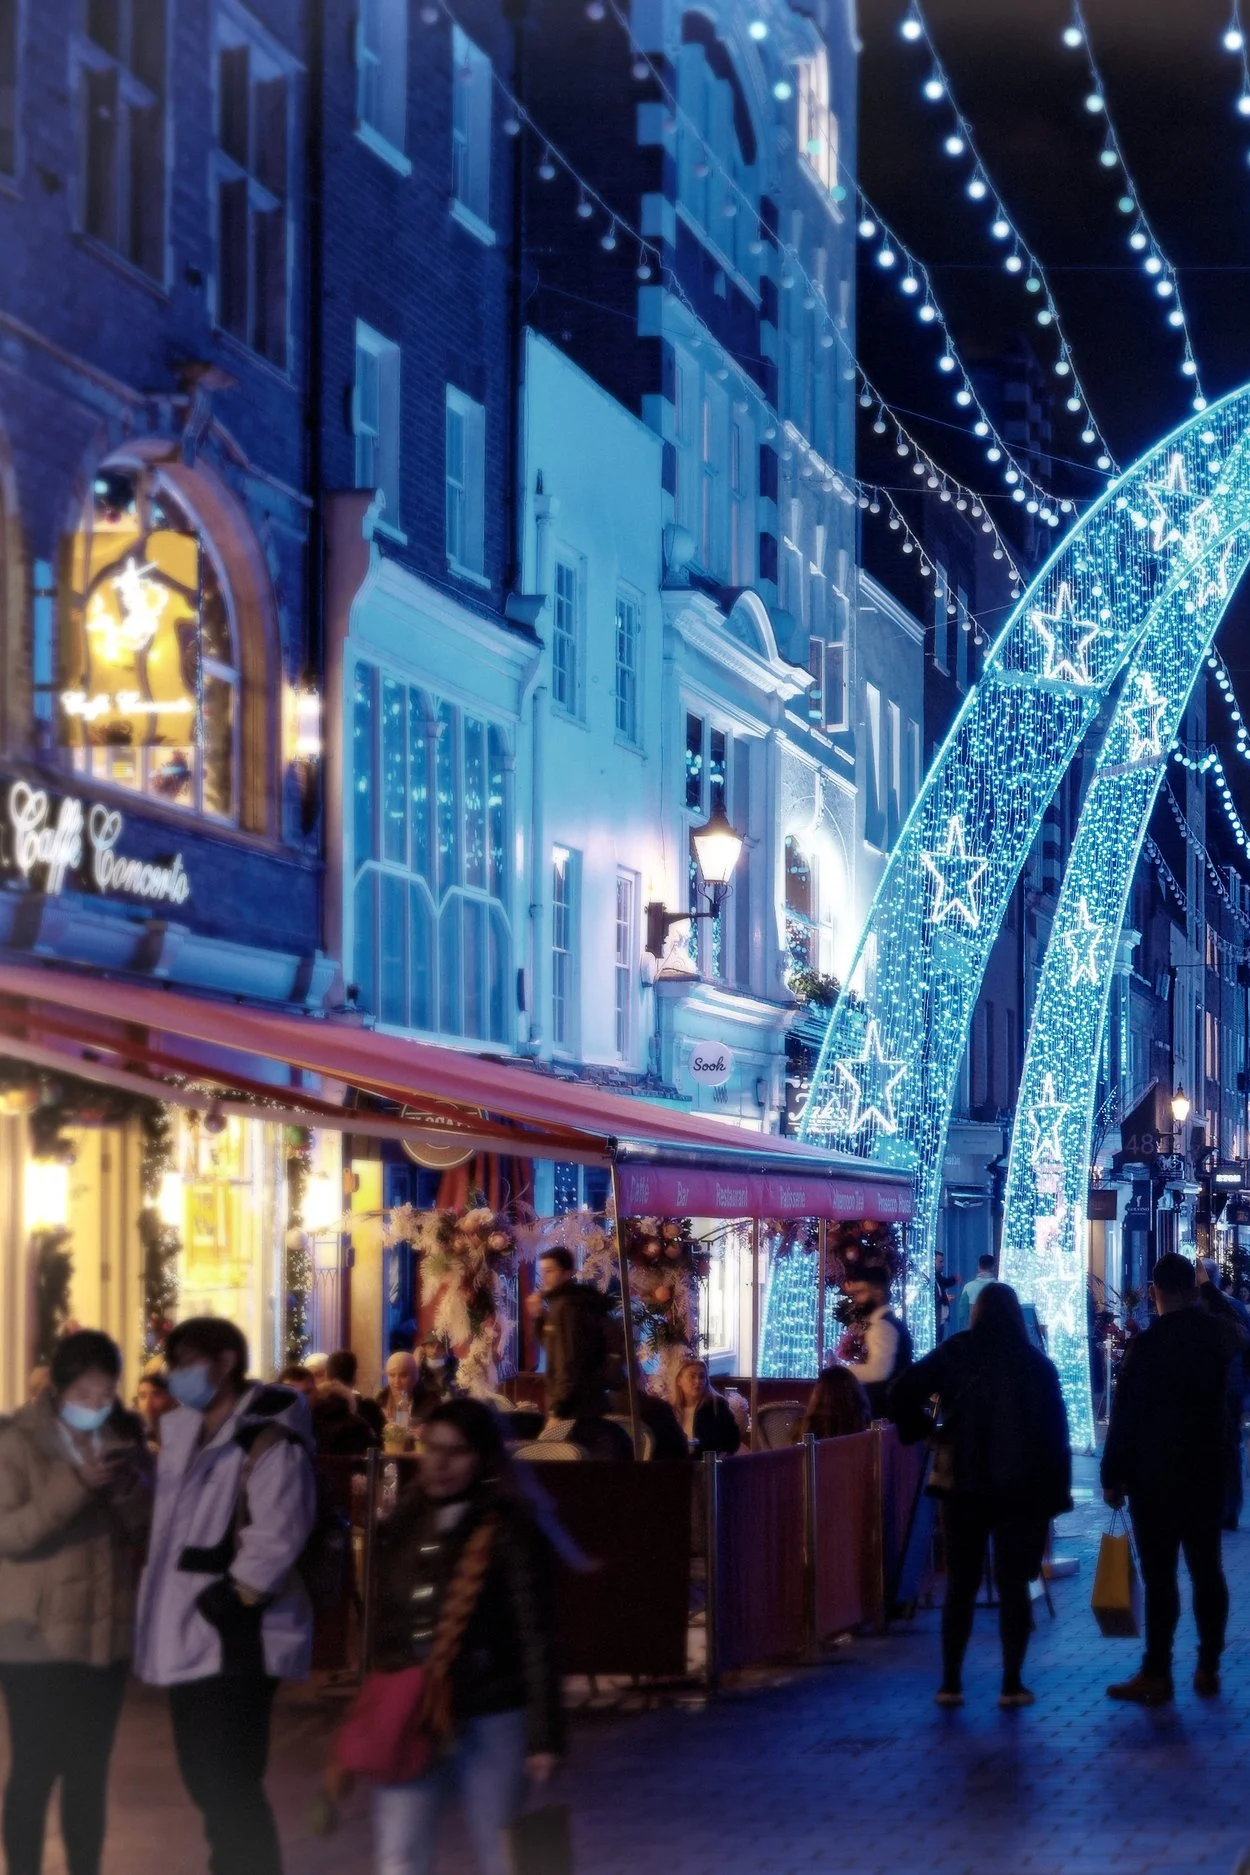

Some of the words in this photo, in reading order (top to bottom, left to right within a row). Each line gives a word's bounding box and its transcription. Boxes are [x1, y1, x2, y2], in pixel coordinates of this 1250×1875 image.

[89, 803, 191, 905] Concerto
[692, 1055, 727, 1073] Sook
[1125, 1133, 1155, 1155] 48
